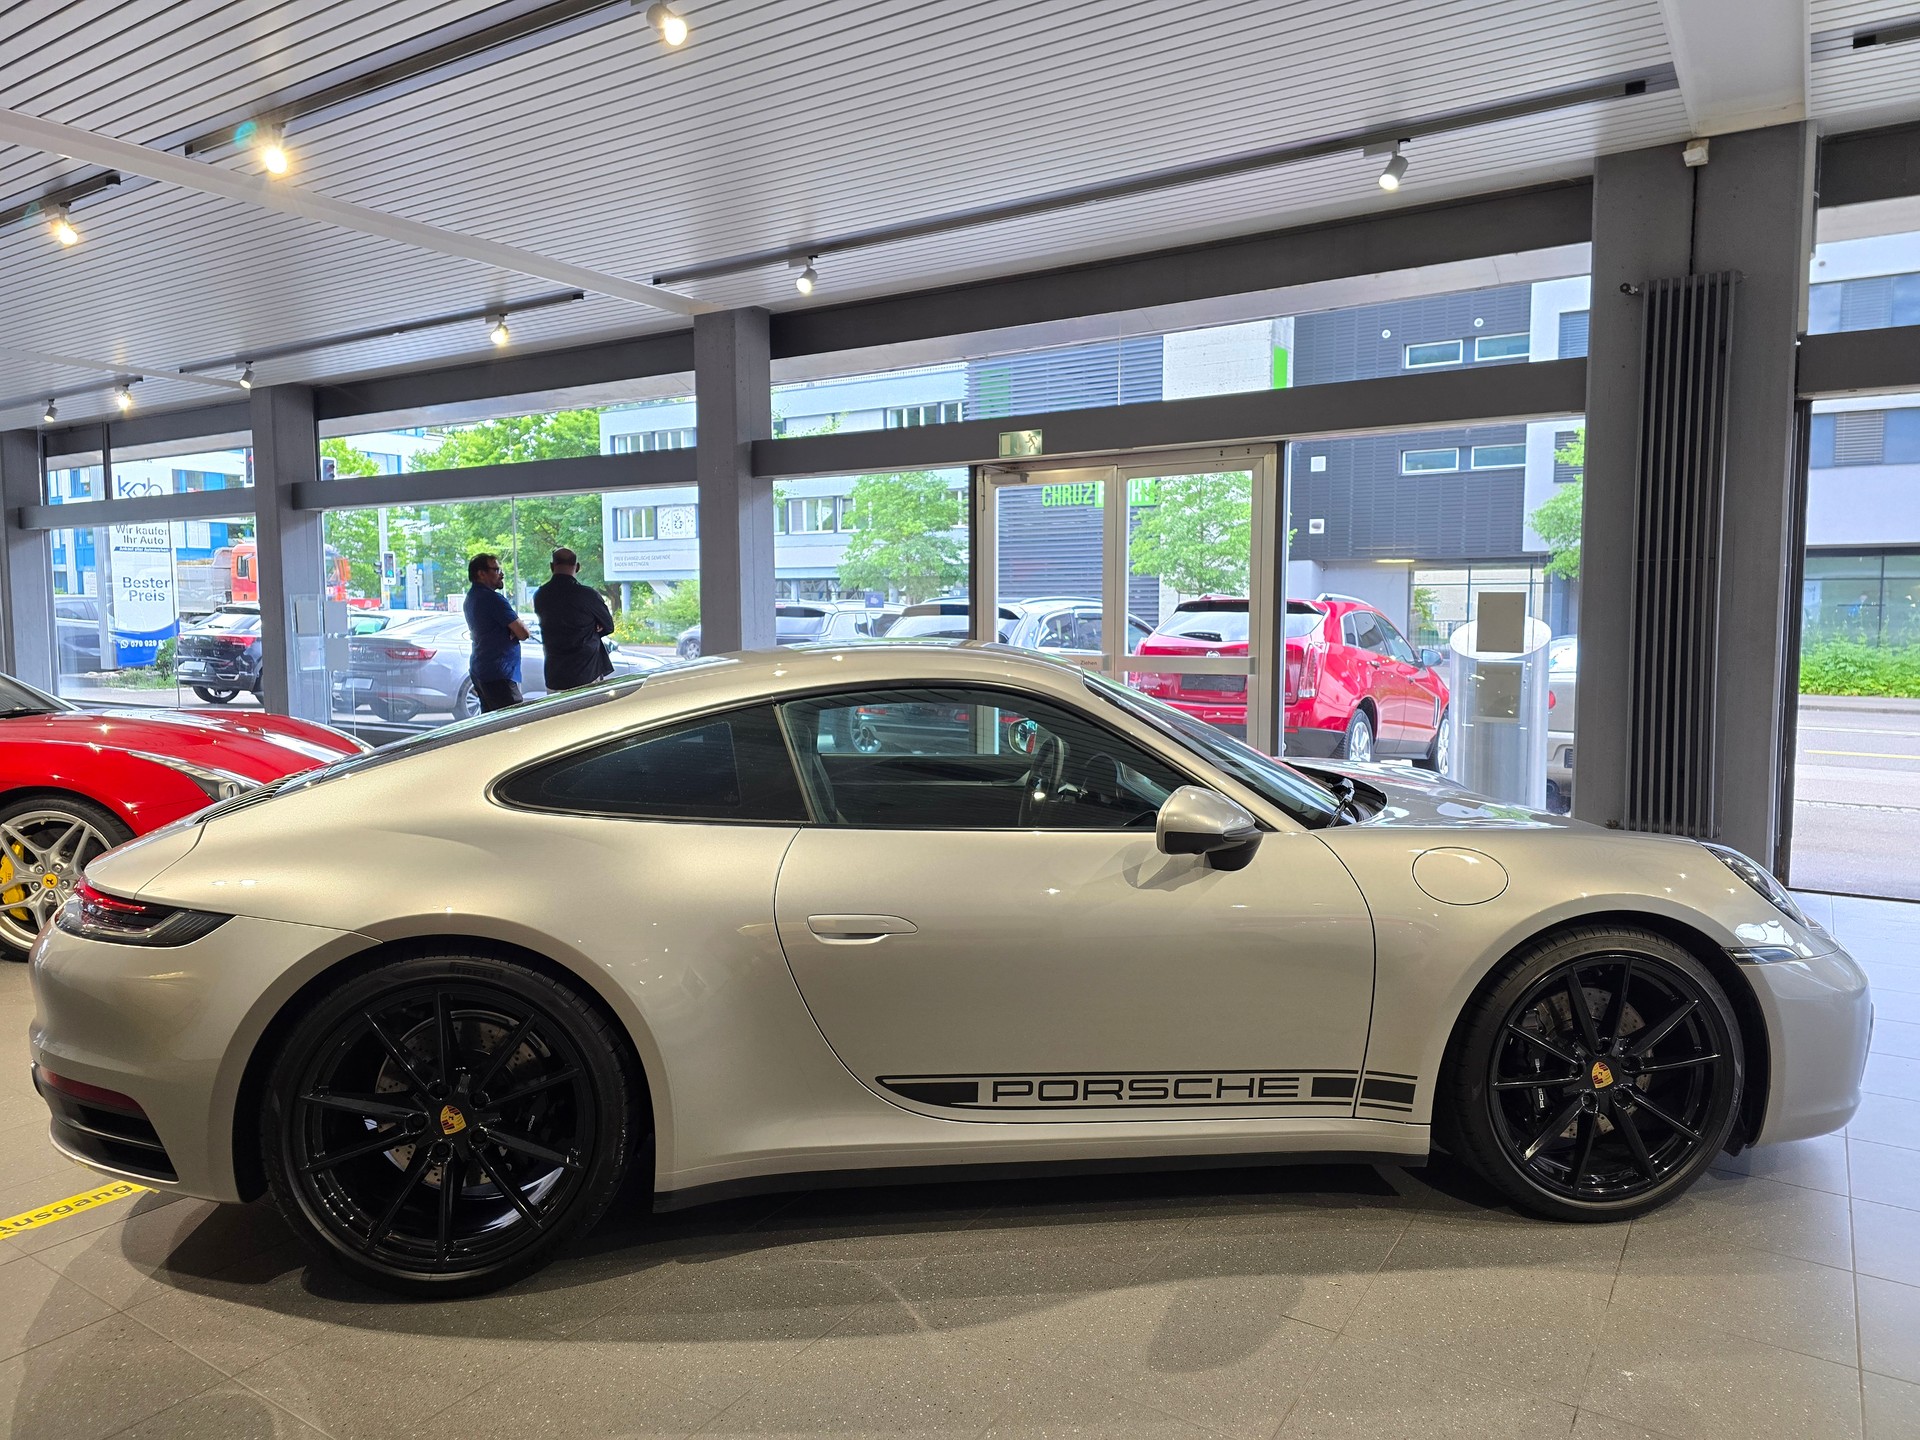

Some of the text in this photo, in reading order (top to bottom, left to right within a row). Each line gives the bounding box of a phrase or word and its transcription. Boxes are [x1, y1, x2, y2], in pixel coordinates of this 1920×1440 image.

[115, 524, 133, 535] Wir
[123, 535, 164, 545] Ihr Auto
[122, 576, 171, 589] Bester
[128, 589, 166, 602] Preis
[991, 1076, 1300, 1103] PORSCHE
